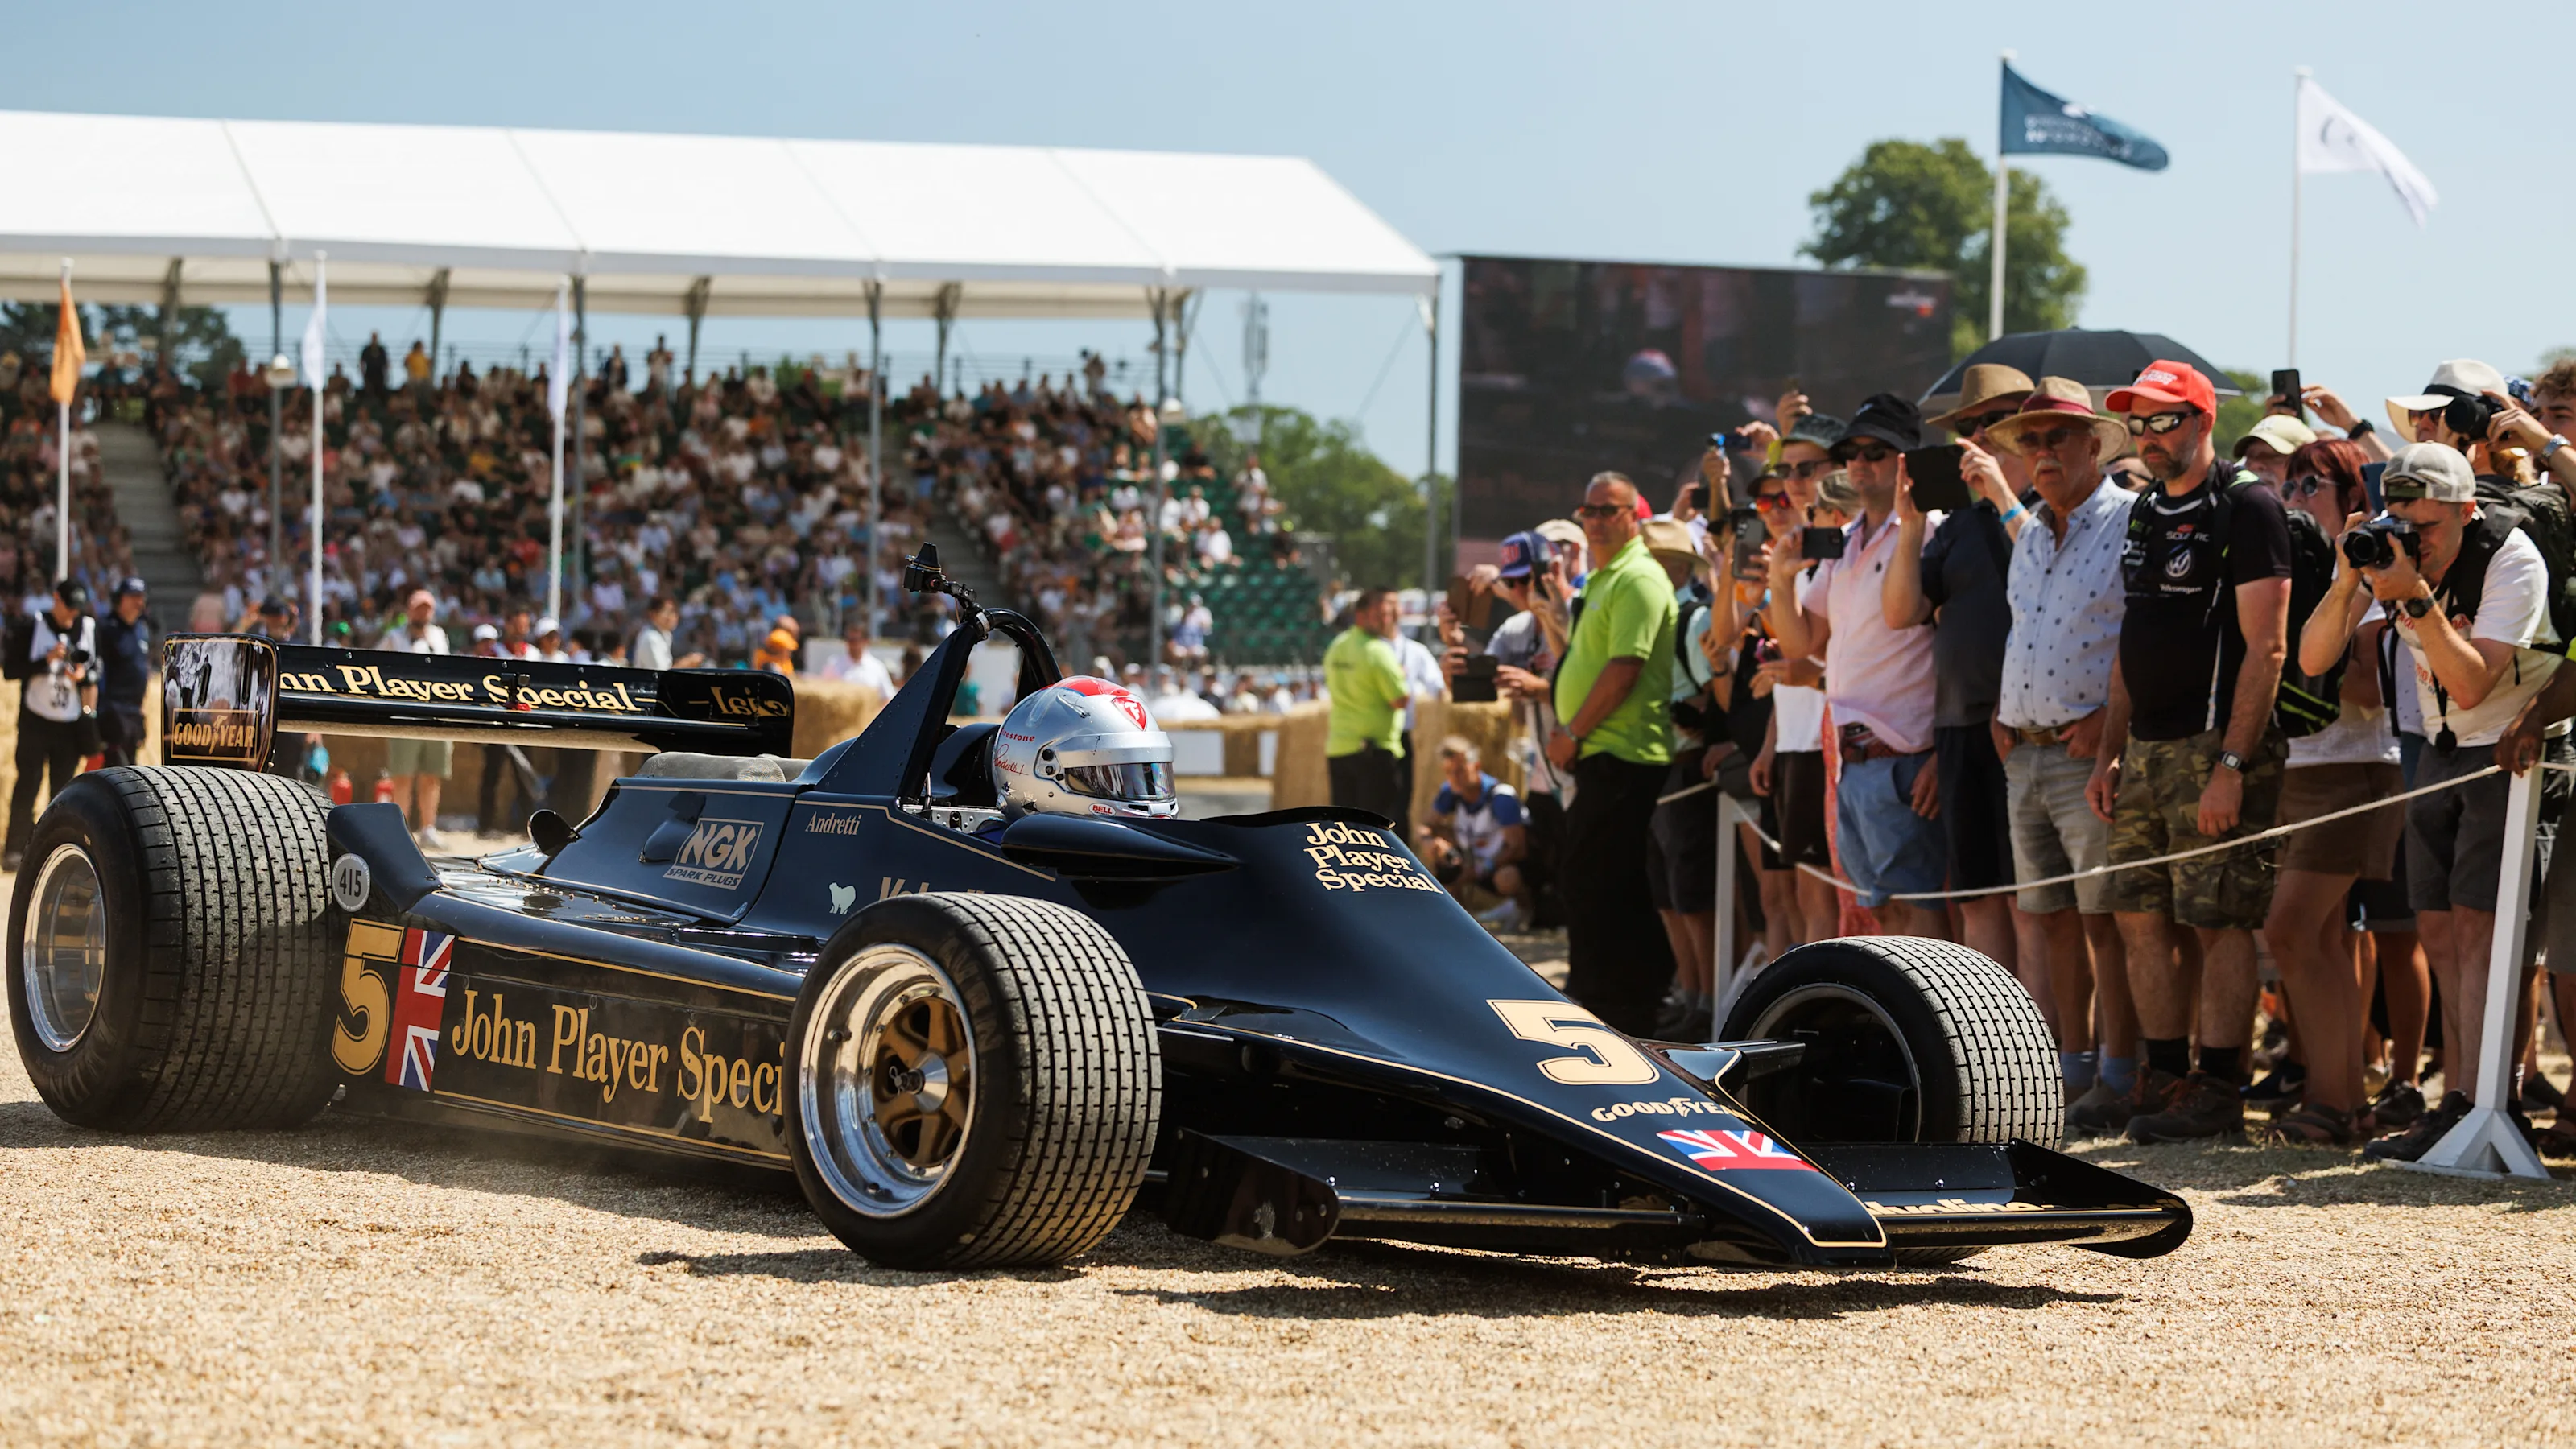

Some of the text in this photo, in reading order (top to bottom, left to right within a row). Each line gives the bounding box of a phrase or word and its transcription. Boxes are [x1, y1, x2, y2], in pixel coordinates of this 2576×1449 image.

[336, 664, 474, 702] Player
[482, 674, 642, 712] Special
[805, 811, 862, 836] Andretti
[1092, 804, 1113, 815] BELL
[679, 824, 757, 872] NGK
[1306, 821, 1390, 849] John
[1303, 844, 1414, 872] Player
[339, 868, 362, 898] 415
[667, 868, 741, 887] SPARK PLUGS
[1315, 869, 1443, 894] Special
[332, 918, 404, 1075] 5
[452, 989, 784, 1123] John Player Speci
[1486, 999, 1660, 1085] 5
